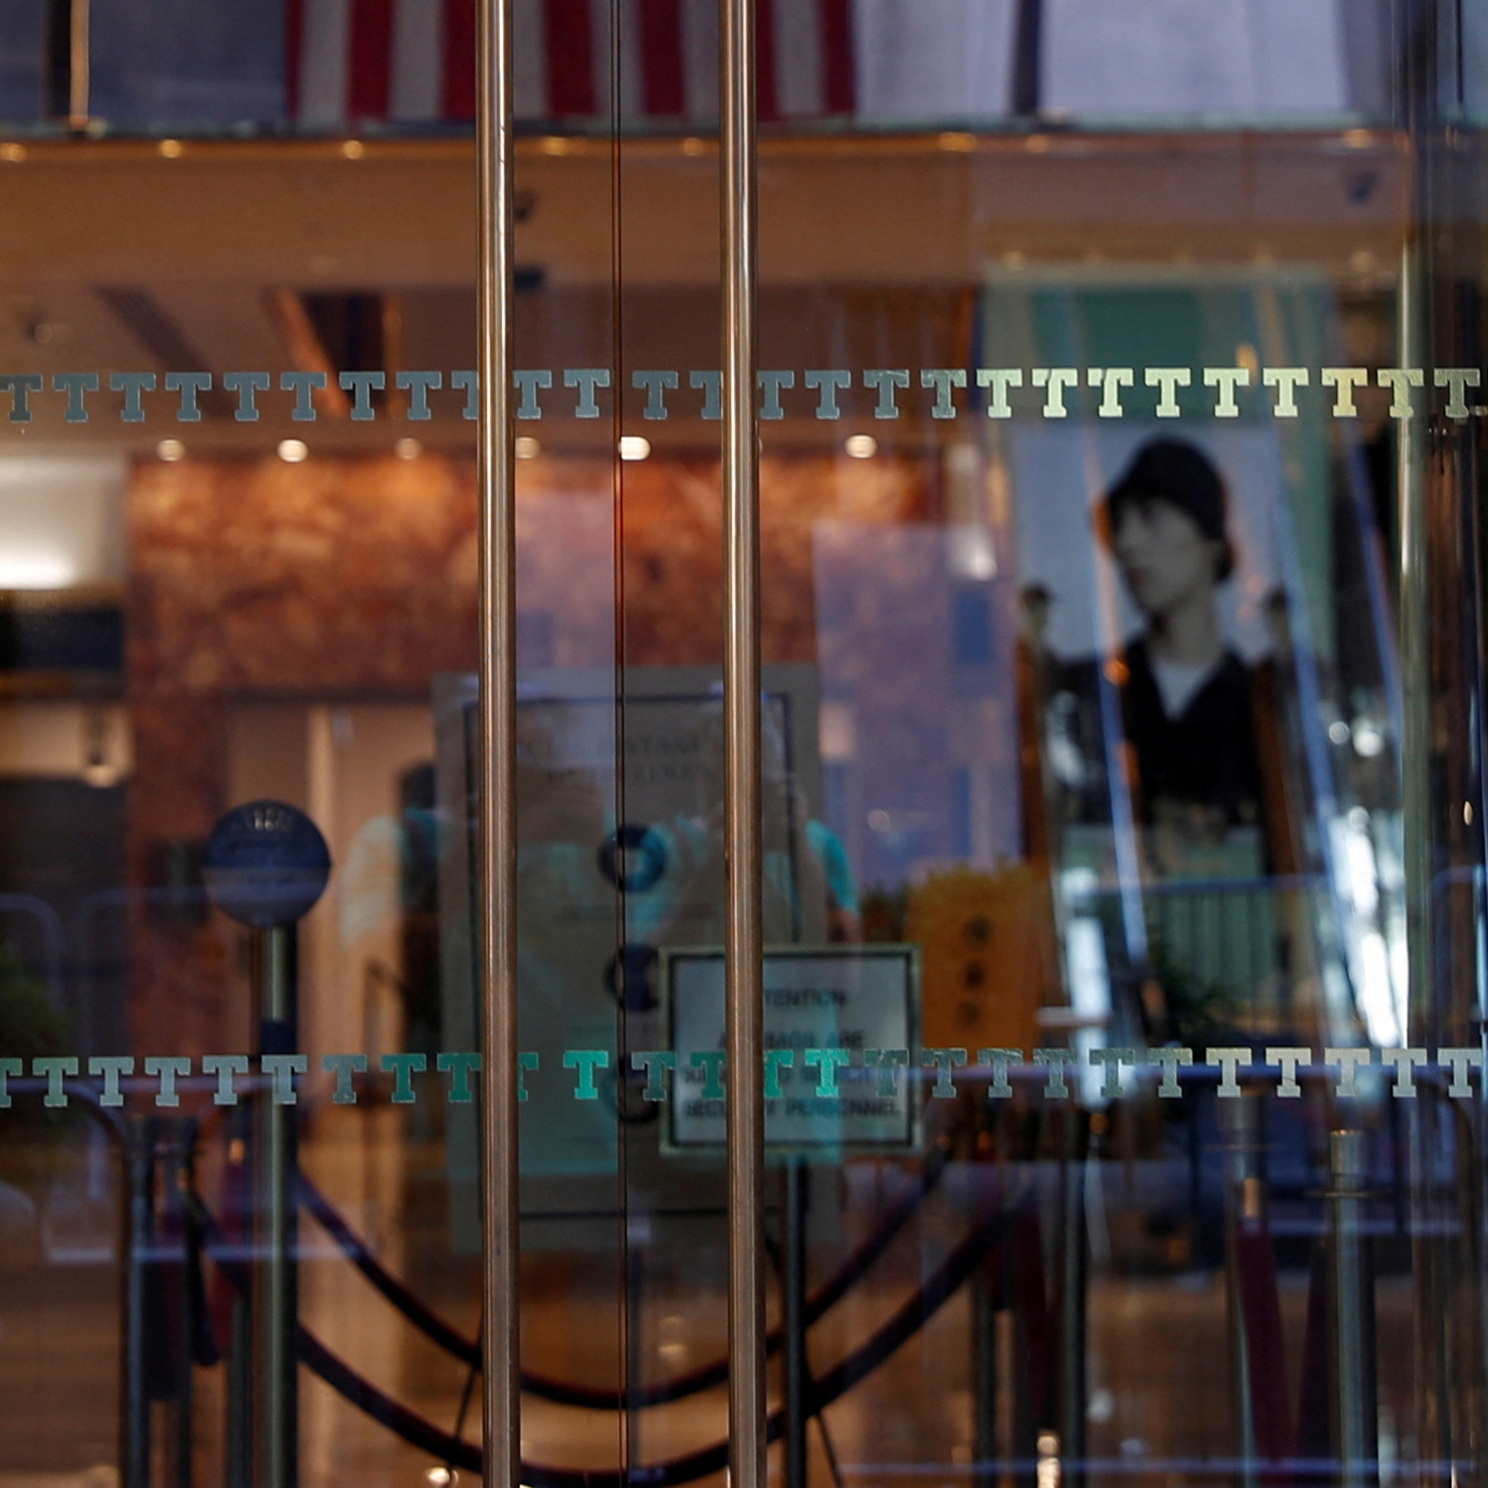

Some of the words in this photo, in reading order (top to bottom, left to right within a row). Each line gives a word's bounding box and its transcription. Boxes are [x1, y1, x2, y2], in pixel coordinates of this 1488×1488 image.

[52, 372, 99, 422] T
[110, 372, 156, 421] T
[165, 372, 212, 421] T
[224, 372, 270, 421] T
[280, 371, 326, 421] T
[340, 371, 386, 420] T
[396, 371, 442, 420] T
[564, 369, 610, 418] T
[632, 370, 678, 419] T
[804, 369, 851, 419] T
[863, 369, 910, 419] T
[920, 369, 967, 418] T
[976, 369, 1023, 418] T
[1032, 368, 1078, 418] T
[1087, 368, 1134, 418] T
[1144, 368, 1191, 418] T
[1203, 367, 1250, 417] T
[1262, 367, 1310, 417] T
[1322, 366, 1368, 416] T
[1377, 366, 1424, 416] T
[1434, 366, 1480, 416] T
[32, 1057, 79, 1108] T
[88, 1056, 134, 1107] T
[144, 1056, 191, 1106] T
[202, 1055, 249, 1106] T
[262, 1055, 307, 1105] T
[322, 1054, 368, 1104] T
[381, 1054, 427, 1104] T
[436, 1053, 482, 1103] T
[563, 1051, 609, 1101] T
[631, 1051, 678, 1101] T
[804, 1048, 850, 1098] T
[864, 1048, 910, 1098] T
[921, 1048, 967, 1098] T
[977, 1048, 1023, 1098] T
[1033, 1048, 1078, 1098] T
[1089, 1047, 1135, 1098] T
[1147, 1047, 1193, 1098] T
[1206, 1047, 1252, 1098] T
[1265, 1047, 1312, 1098] T
[1324, 1047, 1370, 1098] T
[1382, 1048, 1428, 1098] T
[1437, 1048, 1484, 1098] T
